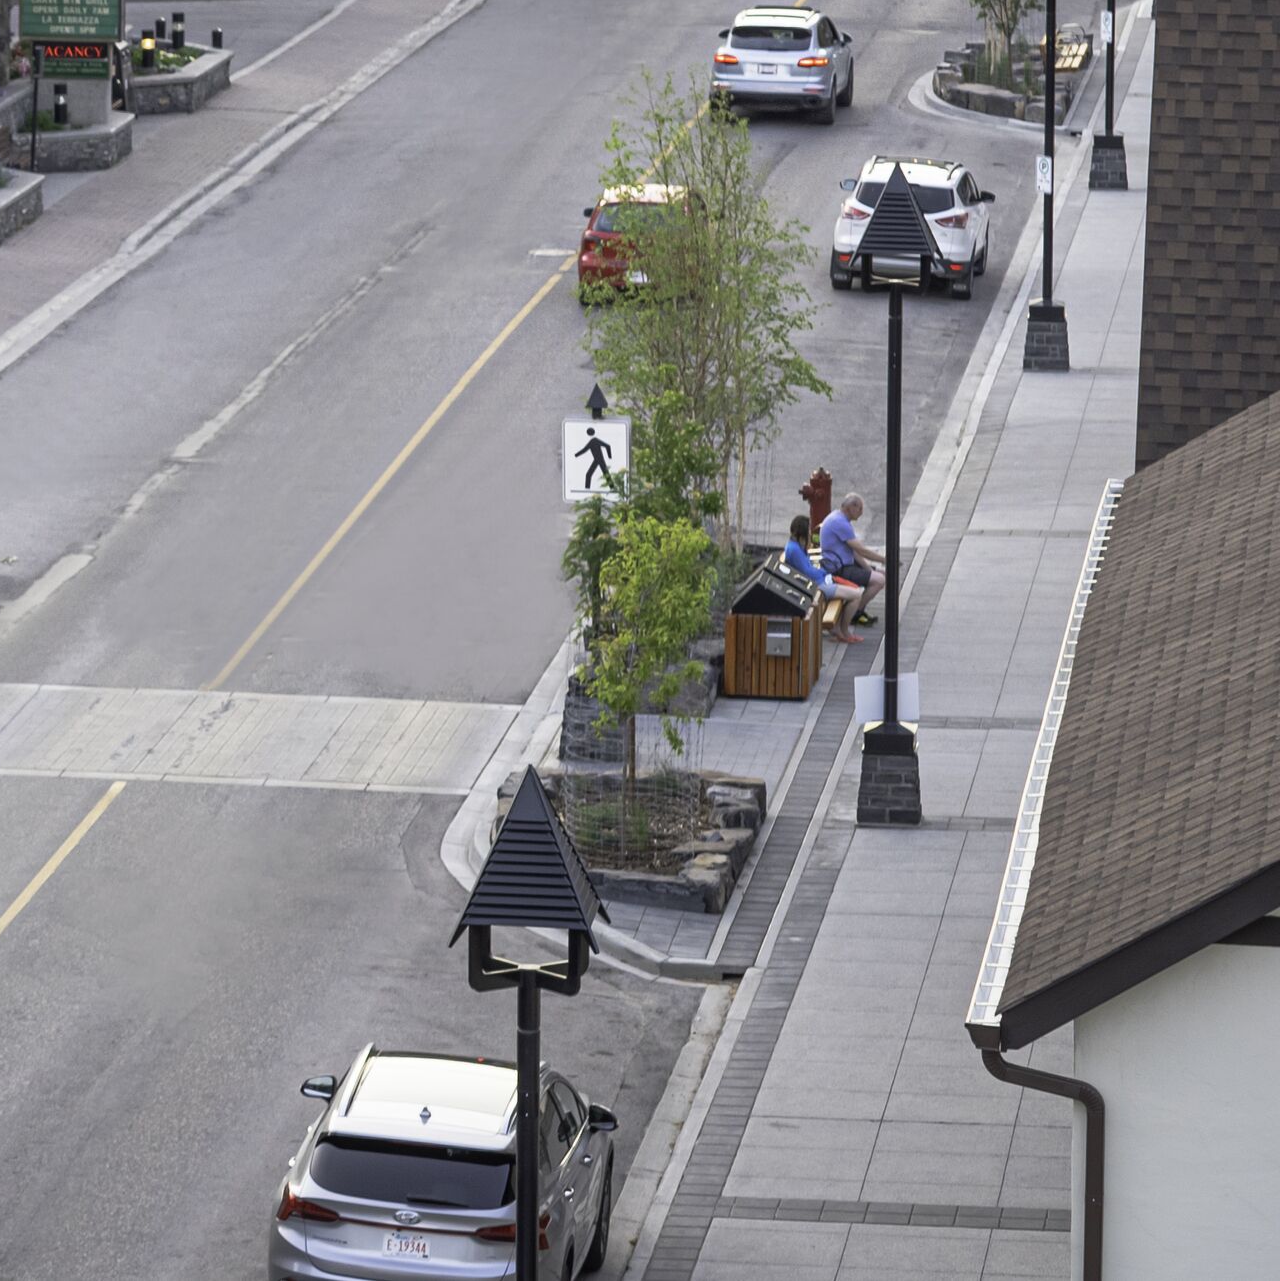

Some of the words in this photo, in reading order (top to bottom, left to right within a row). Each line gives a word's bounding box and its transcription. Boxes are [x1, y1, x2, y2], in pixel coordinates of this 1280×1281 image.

[32, 5, 59, 14] OPENS
[63, 5, 88, 14] DAILY
[41, 15, 53, 24] LA
[58, 15, 100, 24] TERRAZZA
[49, 25, 76, 34] OPENS
[45, 45, 103, 58] ACANCY
